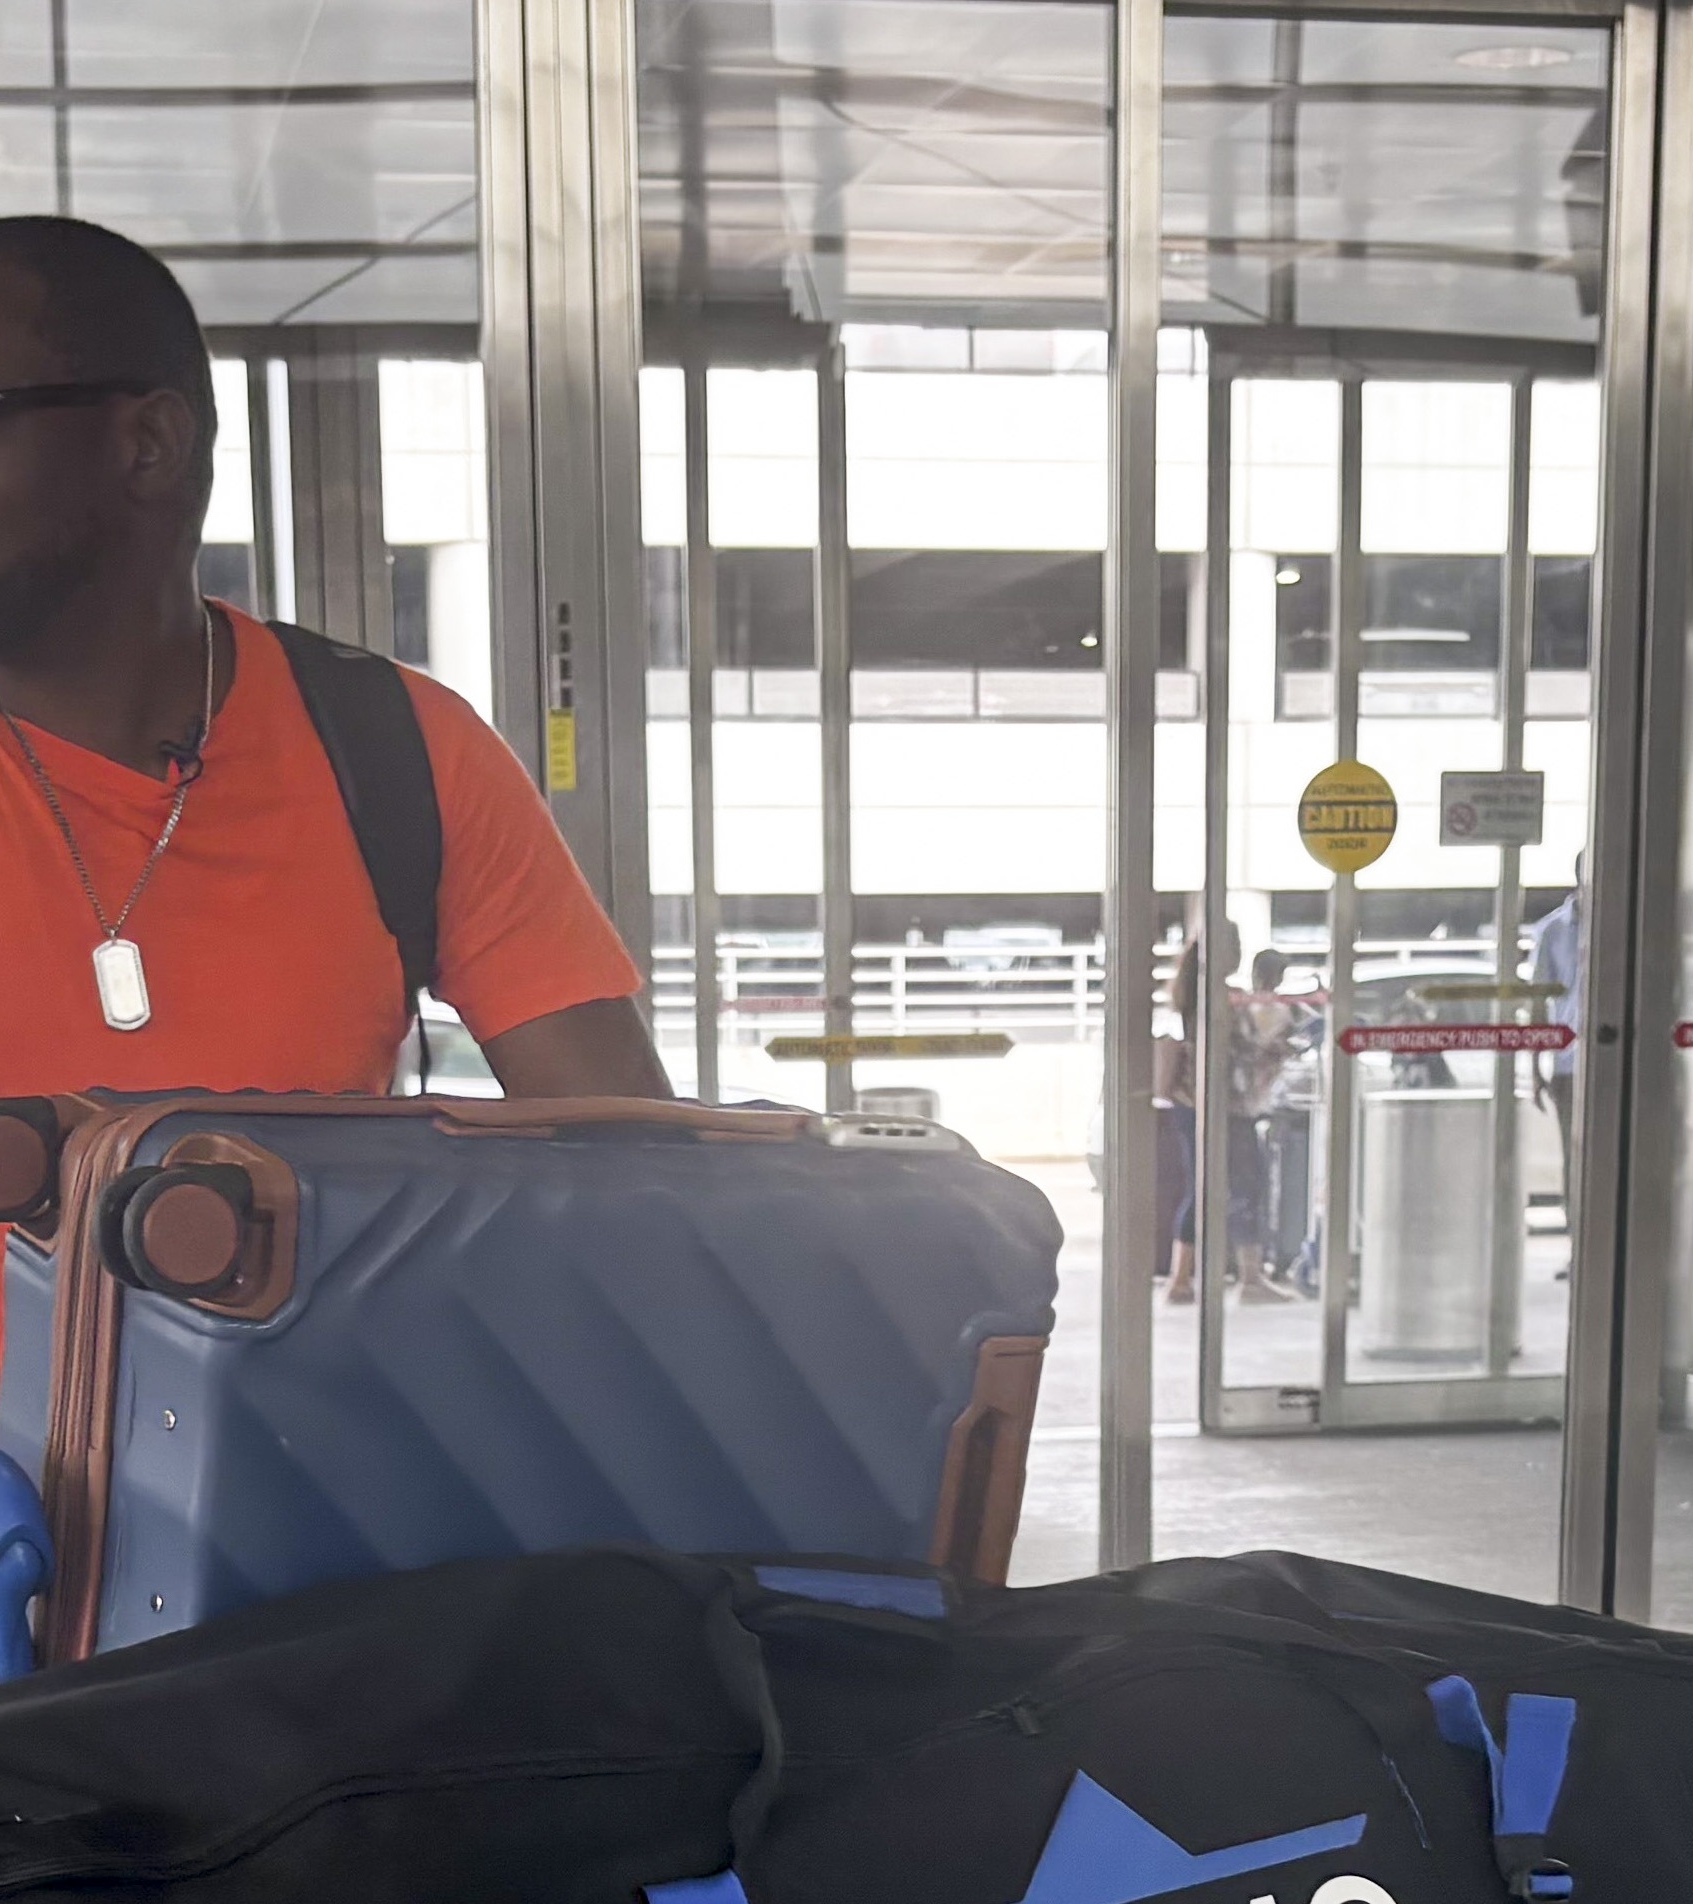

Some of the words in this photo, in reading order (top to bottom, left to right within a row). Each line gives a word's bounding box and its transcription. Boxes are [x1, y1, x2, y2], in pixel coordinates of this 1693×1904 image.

[1303, 804, 1395, 831] CAUTION
[1368, 1030, 1458, 1049] EMERGENCY
[1501, 1029, 1520, 1048] TO
[1522, 1028, 1564, 1046] OPEN
